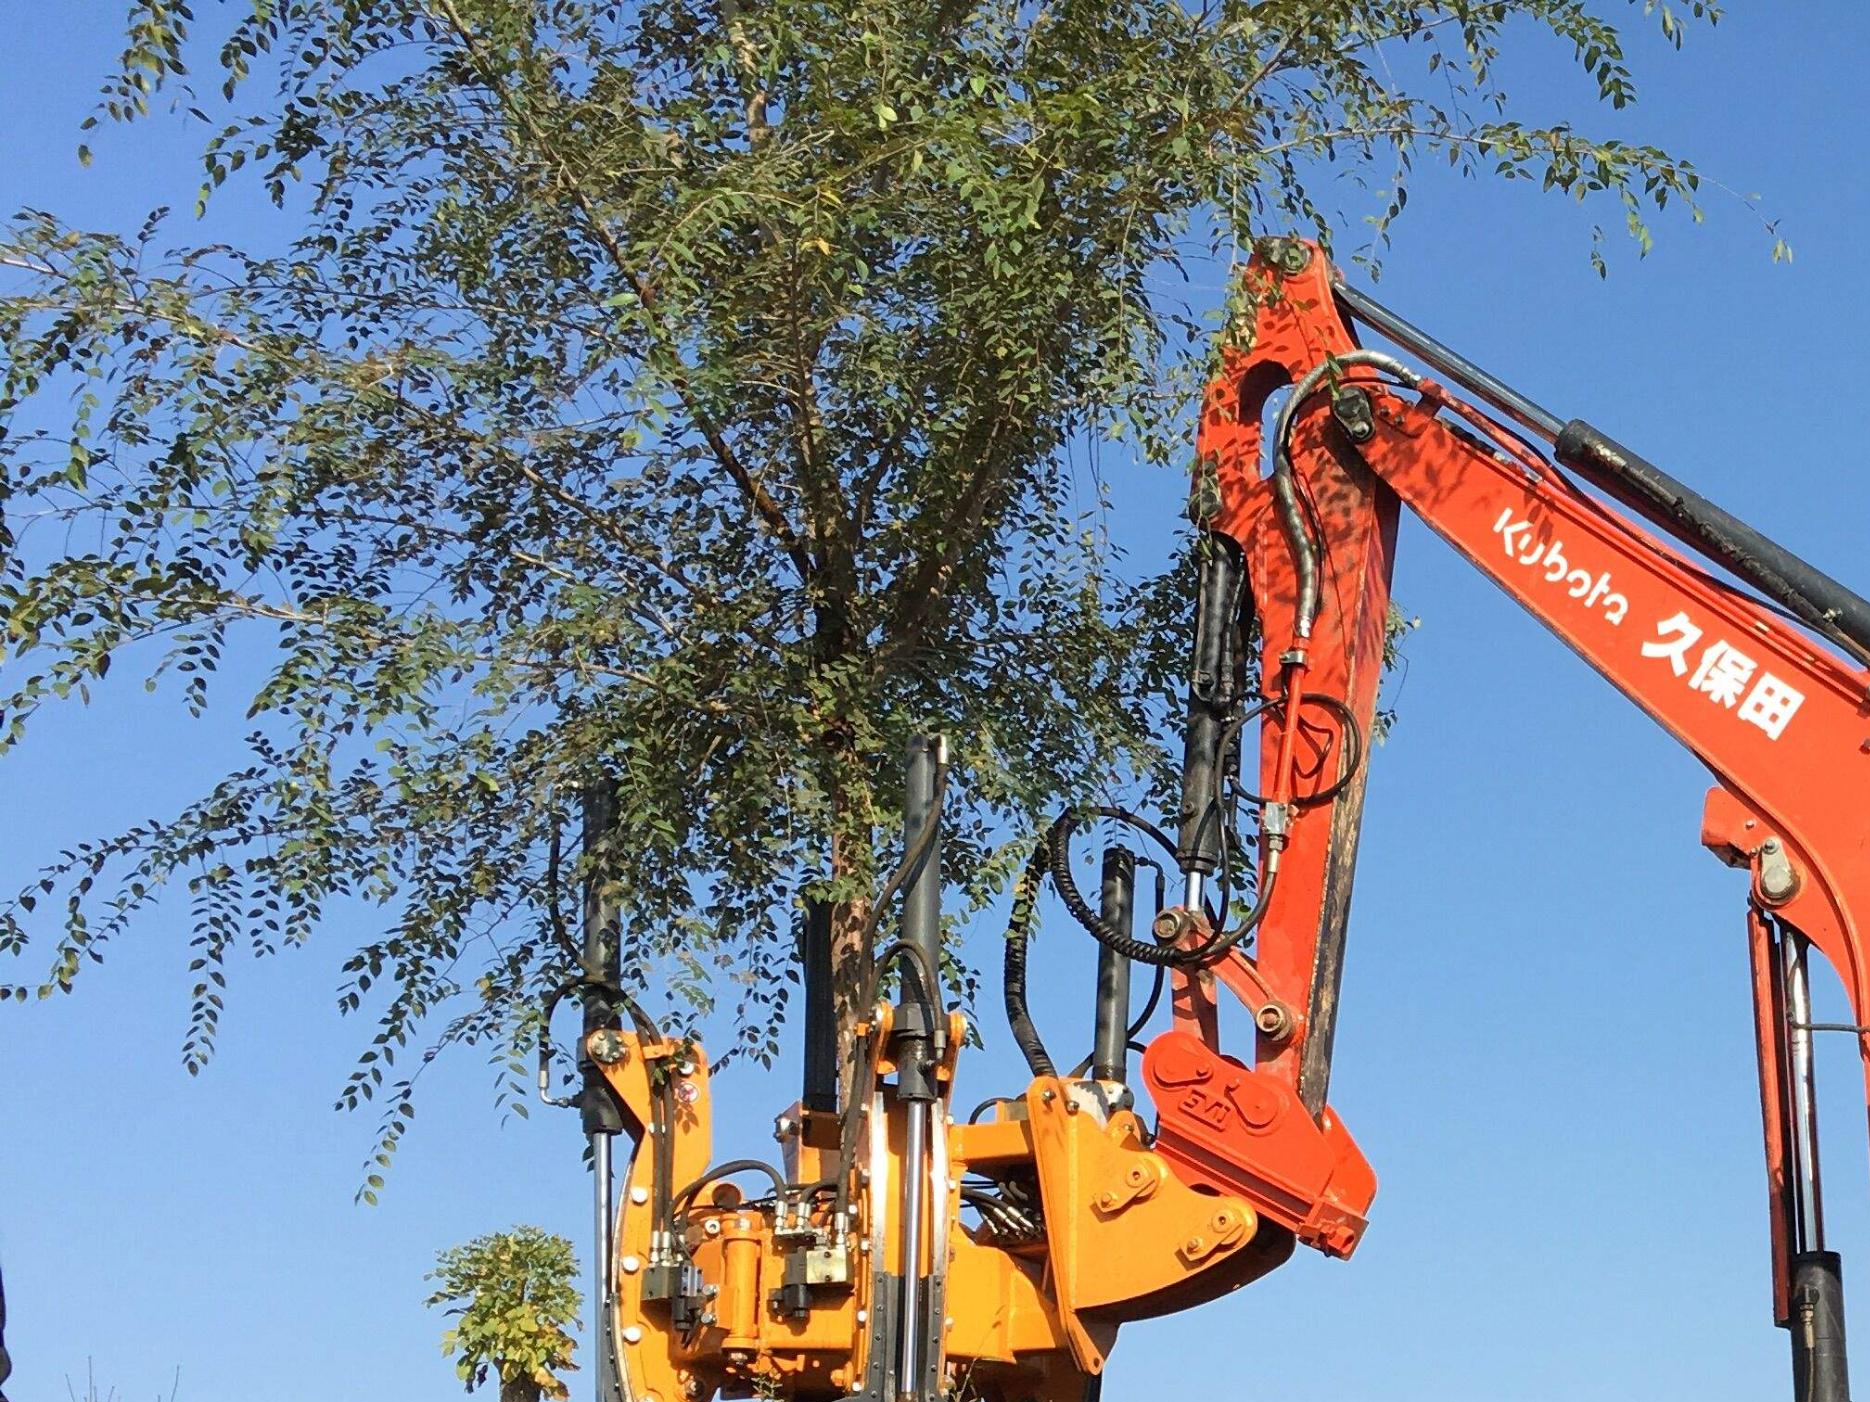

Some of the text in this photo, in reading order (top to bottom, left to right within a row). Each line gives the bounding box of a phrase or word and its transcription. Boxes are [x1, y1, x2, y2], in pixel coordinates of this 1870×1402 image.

[1493, 507, 1629, 626] Kubota
[1641, 611, 1805, 741] 久保田
